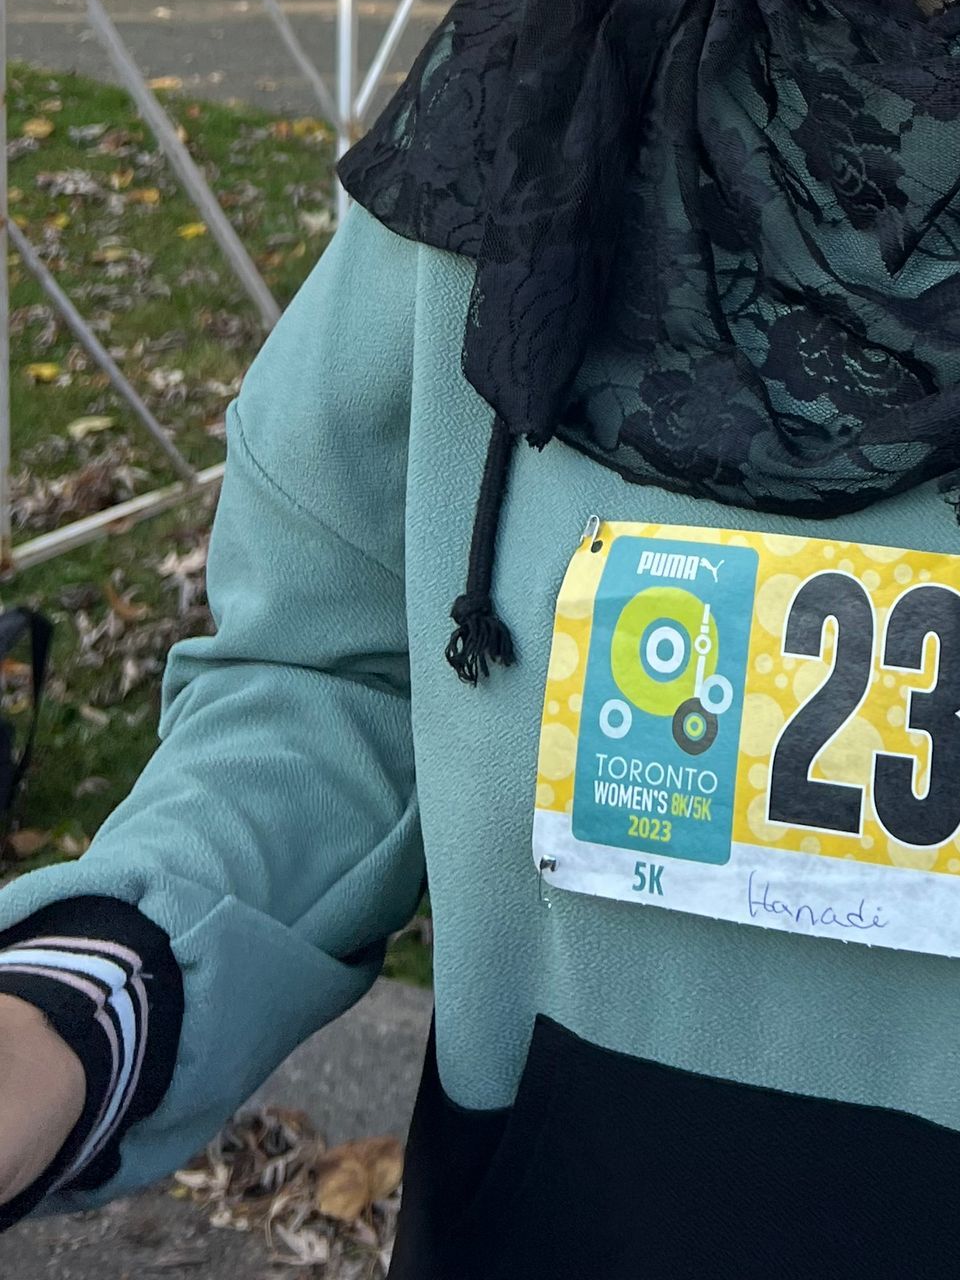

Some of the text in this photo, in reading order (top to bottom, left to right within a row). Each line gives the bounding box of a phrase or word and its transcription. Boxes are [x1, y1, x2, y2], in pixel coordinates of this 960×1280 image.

[636, 551, 700, 581] PUMA
[595, 753, 718, 794] TORONTO
[594, 780, 712, 821] WOMEN'S 8K/5K
[627, 815, 673, 843] 2023
[632, 861, 665, 896] 5K
[748, 870, 889, 929] Hanadi
